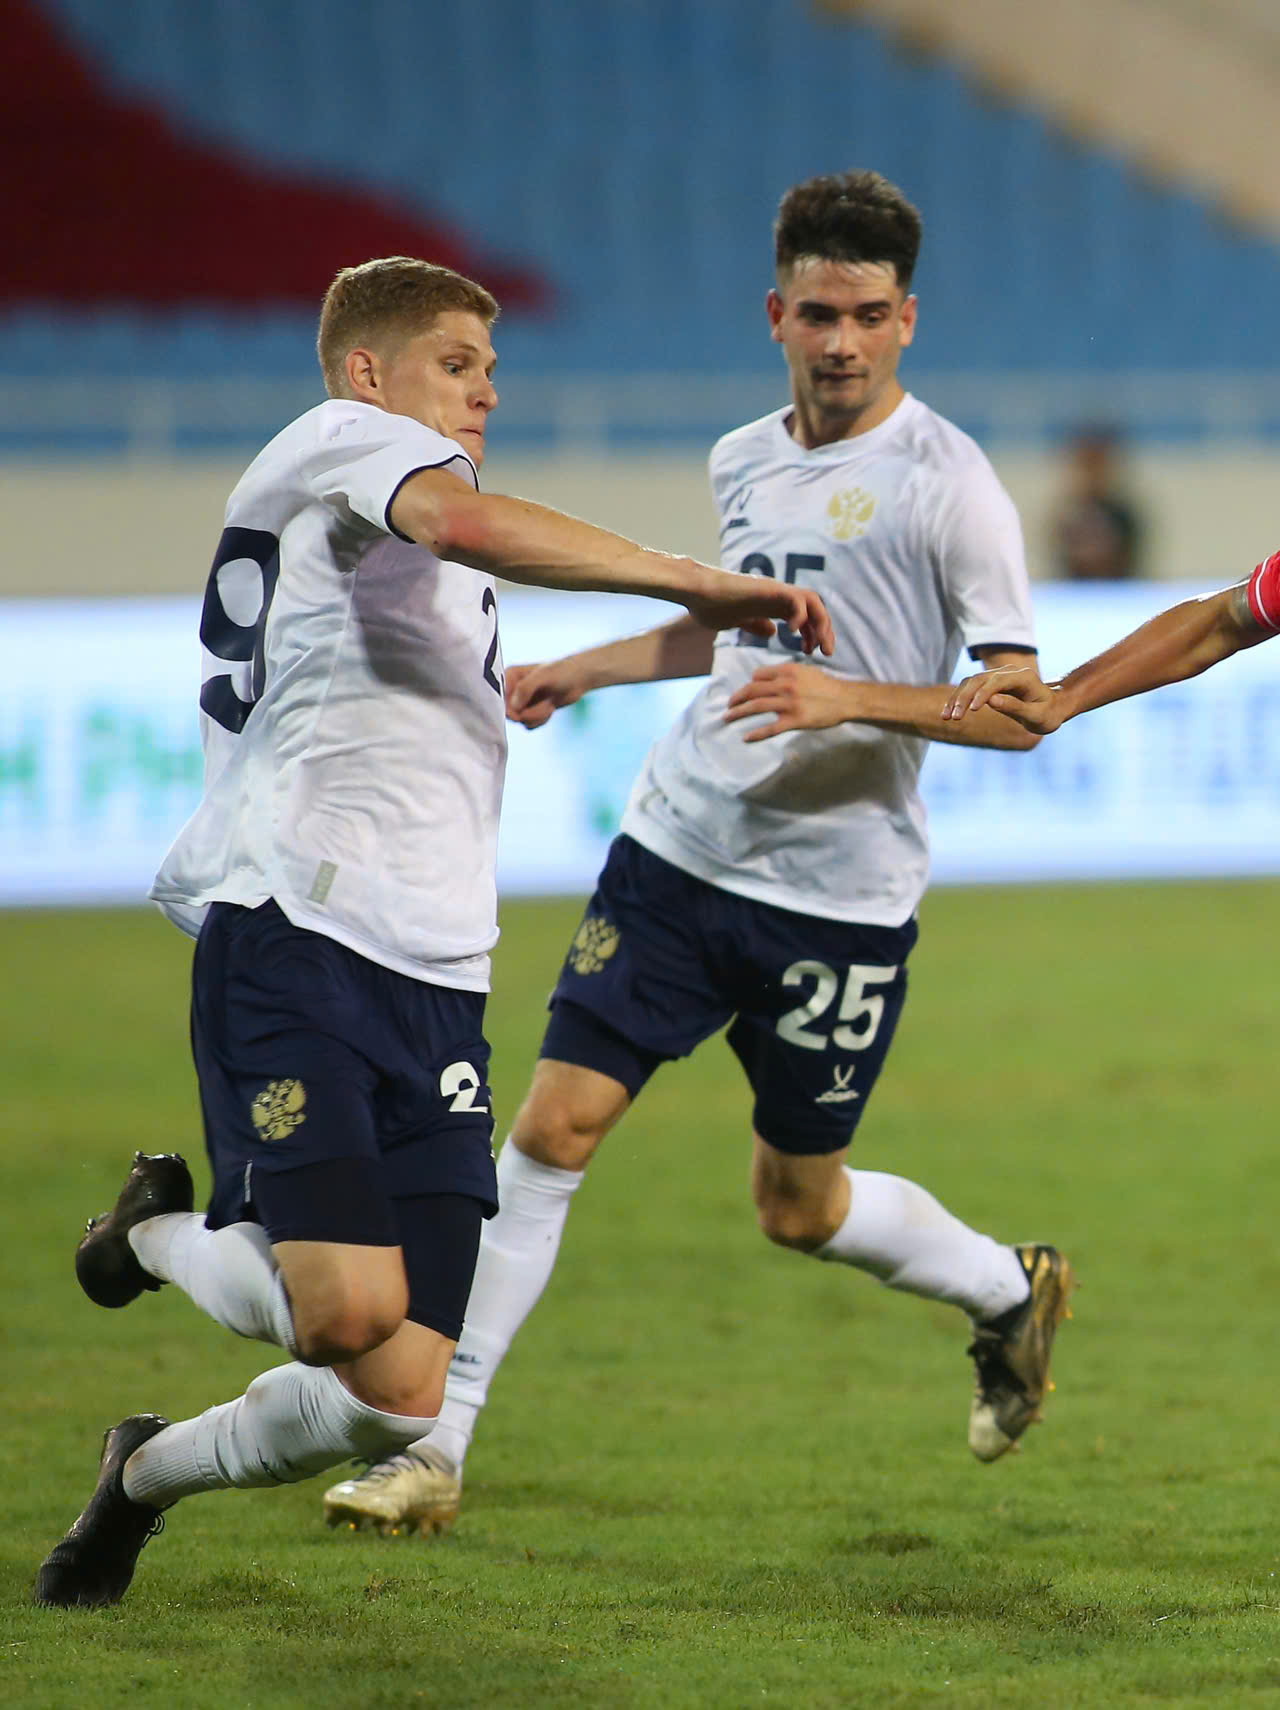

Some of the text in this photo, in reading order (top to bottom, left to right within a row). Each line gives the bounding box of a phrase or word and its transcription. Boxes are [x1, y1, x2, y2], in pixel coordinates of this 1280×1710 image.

[482, 586, 505, 698] 2
[775, 959, 898, 1051] 25
[440, 1061, 492, 1116] 2
